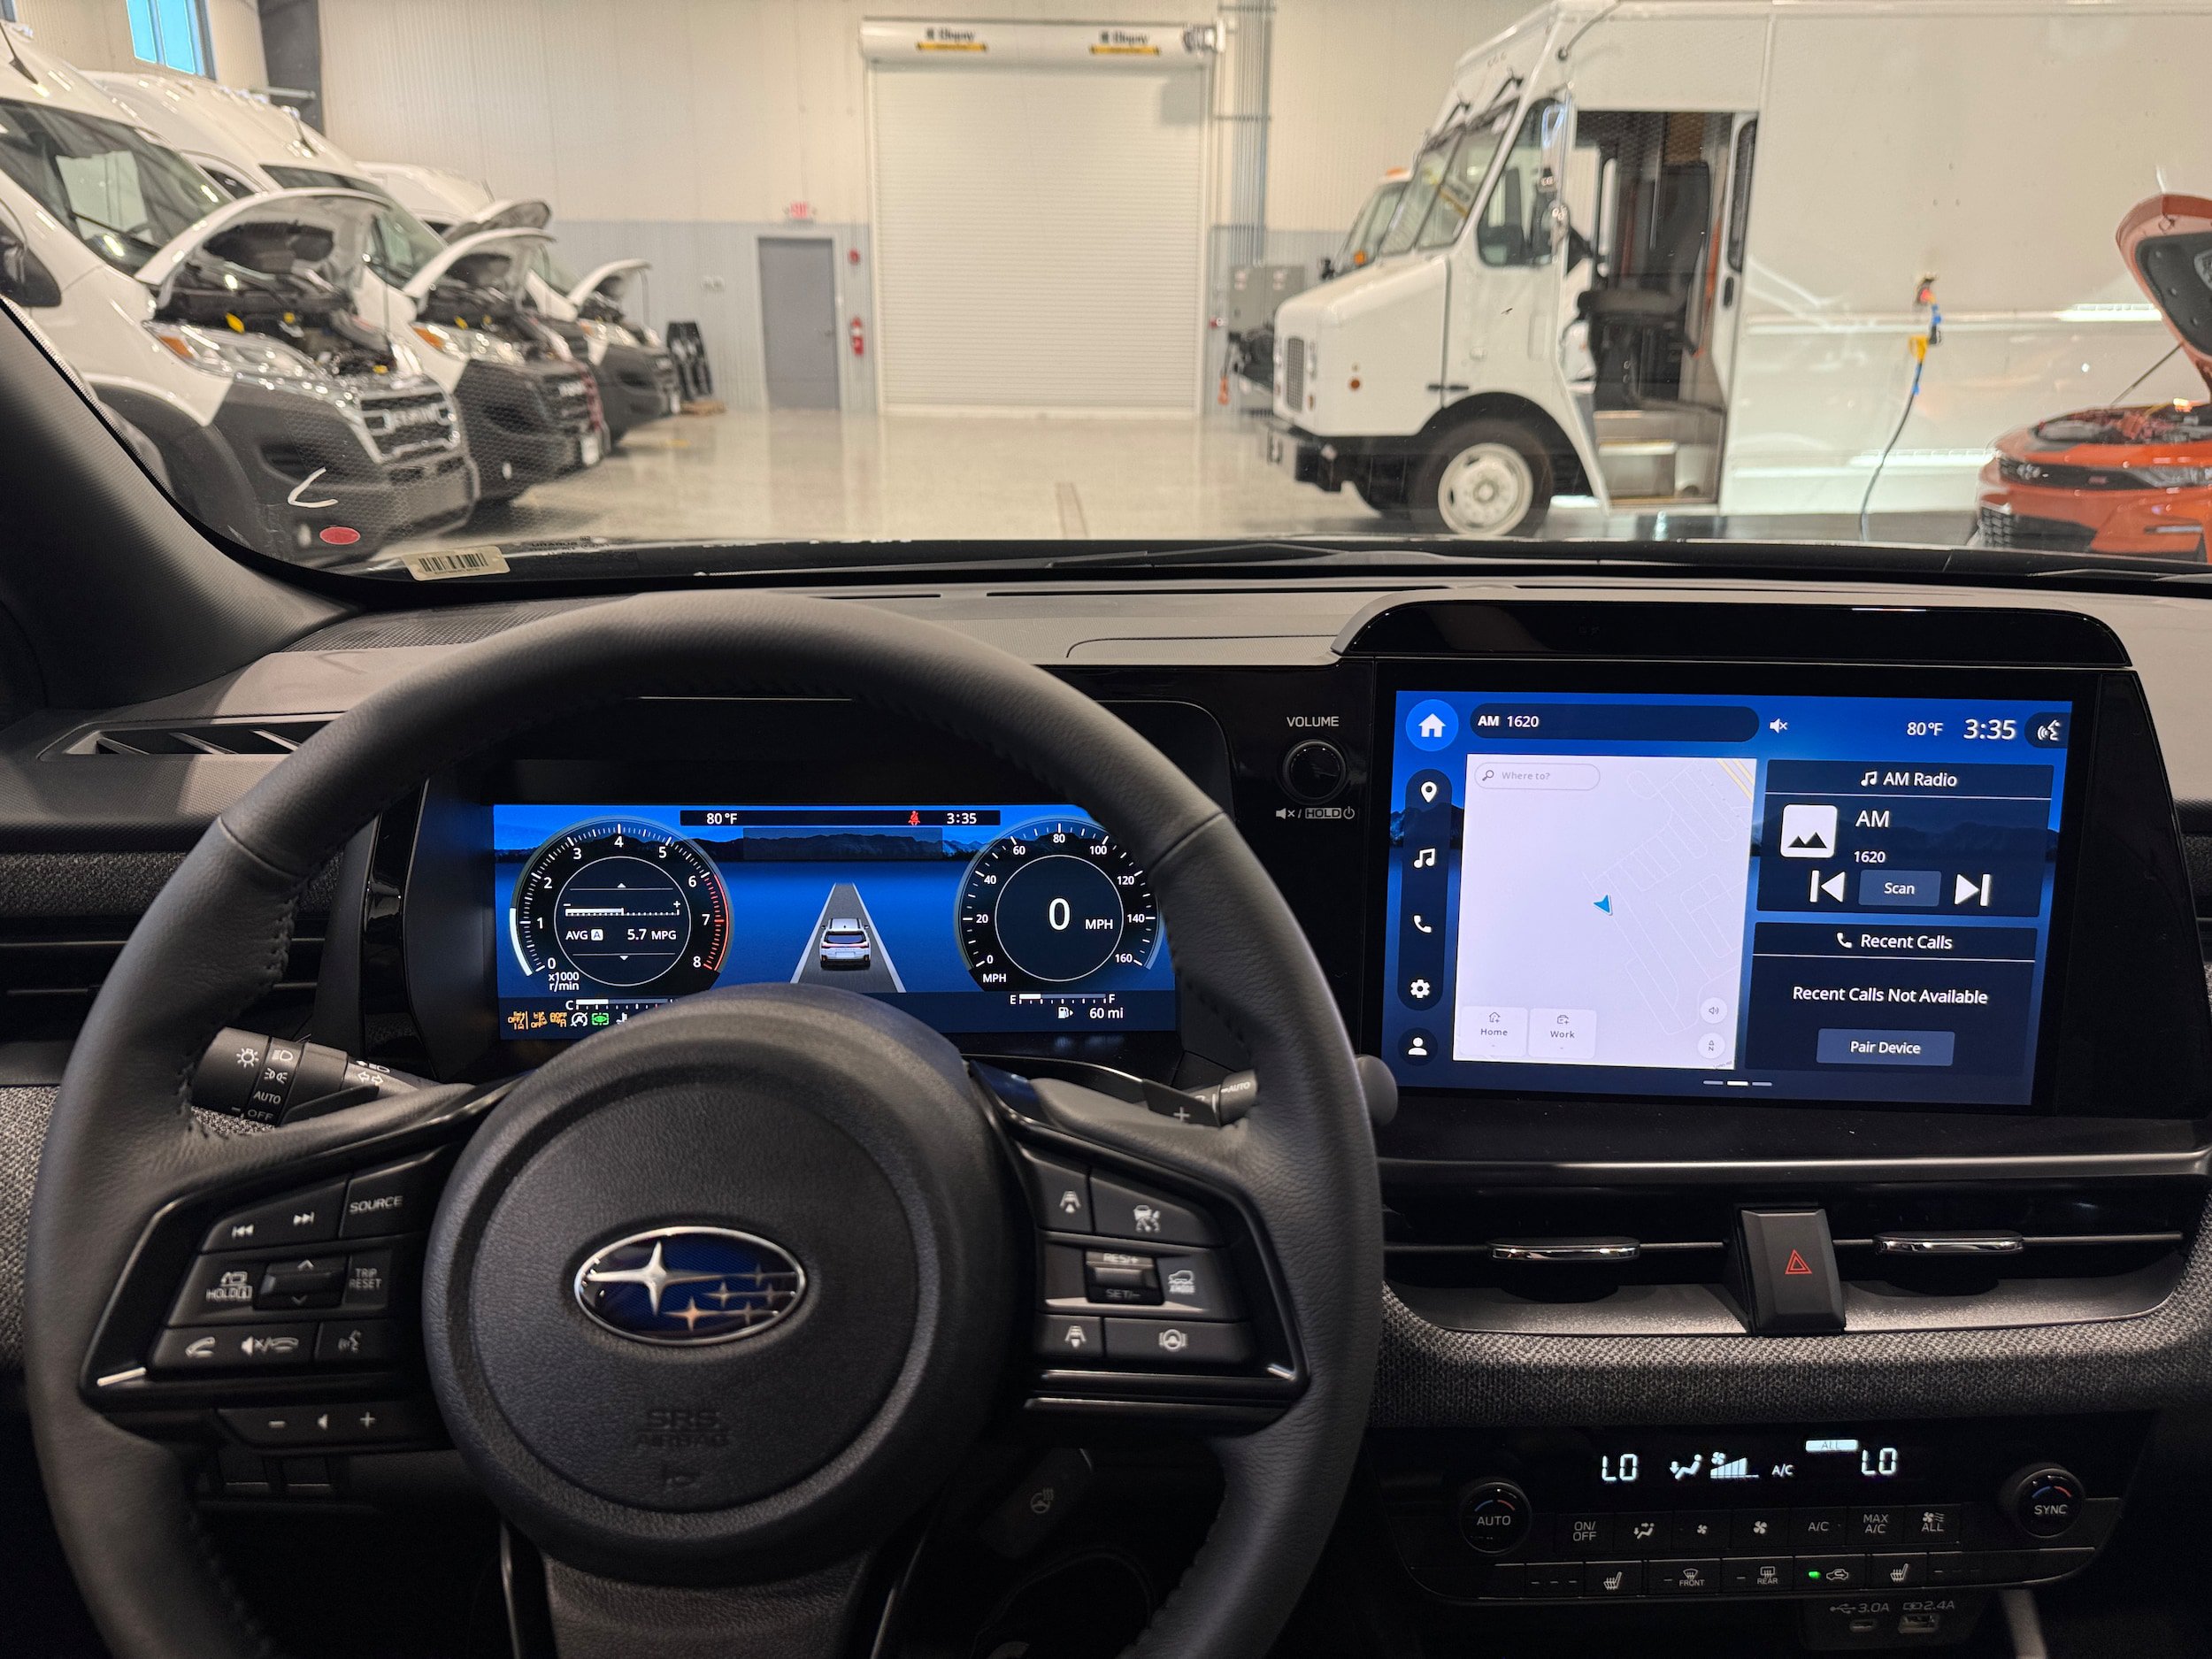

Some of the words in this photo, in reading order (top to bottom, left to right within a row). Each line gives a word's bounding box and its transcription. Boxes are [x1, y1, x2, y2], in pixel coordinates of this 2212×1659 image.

[1286, 716, 1340, 727] VOLUME
[1478, 715, 1500, 727] AM
[1506, 715, 1540, 728] 1620
[1906, 721, 1944, 737] 80°F
[1963, 719, 2016, 740] 3:35
[1502, 771, 1533, 781] Where
[1536, 771, 1551, 781] to?
[1883, 772, 1909, 787] AM
[1913, 772, 1957, 787] Radio
[706, 812, 738, 825] 80°F
[946, 812, 977, 825] 3:35
[1306, 809, 1341, 818] HOLD
[1855, 810, 1890, 828] AM
[614, 836, 624, 848] 4
[1053, 833, 1065, 844] 80
[572, 848, 582, 860] 3
[658, 846, 667, 858] 5
[1012, 845, 1025, 856] 60
[1089, 845, 1107, 856] 100
[1854, 850, 1886, 864] 1620
[543, 877, 553, 889] 2
[687, 876, 697, 887] 6
[984, 874, 997, 886] 40
[1117, 874, 1135, 886] 120
[1884, 881, 1915, 895] Scan
[976, 914, 989, 924] 20
[1048, 897, 1071, 931] 0
[1085, 918, 1113, 930] MPH
[1126, 913, 1145, 924] 140
[536, 917, 544, 929] 1
[701, 914, 710, 926] 7
[565, 930, 588, 941] AVG
[626, 929, 647, 941] 5.7
[651, 930, 677, 941] MPG
[1860, 933, 1914, 949] Recent
[1916, 934, 1953, 949] Calls
[547, 957, 557, 970] 0
[692, 956, 702, 968] 8
[986, 955, 994, 964] 0
[1114, 953, 1133, 964] 160
[549, 972, 580, 981] x1000
[982, 973, 1007, 984] MPH
[549, 981, 580, 992] r/min
[1010, 995, 1017, 1004] E
[1109, 994, 1116, 1004] F
[1793, 987, 1845, 1002] Recent
[1848, 987, 1884, 1002] Calls
[1887, 988, 1915, 1002] Not
[1918, 988, 1988, 1004] Available
[565, 1000, 574, 1010] C
[1089, 1008, 1104, 1018] 60
[1107, 1007, 1124, 1018] mi
[1480, 1027, 1509, 1038] Home
[1549, 1029, 1576, 1040] Work
[1850, 1041, 1875, 1055] Pair
[1878, 1041, 1921, 1055] Device
[1227, 1081, 1251, 1093] AUTO
[253, 1090, 281, 1104] AUTO
[247, 1109, 274, 1121] OFF
[349, 1195, 403, 1214] SOURCE
[355, 1268, 378, 1279] TRIP
[349, 1278, 382, 1289] RESET
[648, 1409, 720, 1429] SRS
[1820, 1441, 1840, 1450] ALL
[1771, 1464, 1794, 1477] A/C
[2034, 1505, 2067, 1515] SYNC
[1477, 1516, 1511, 1525] AUTO
[1863, 1514, 1889, 1524] MAX
[1574, 1521, 1596, 1532] ON/
[1808, 1521, 1829, 1532] A/C
[1865, 1524, 1887, 1534] A/C
[1921, 1522, 1944, 1532] ALL
[1572, 1532, 1597, 1541] OFF
[1858, 1602, 1890, 1613] 3.0A
[1924, 1601, 1955, 1610] 2.4A
